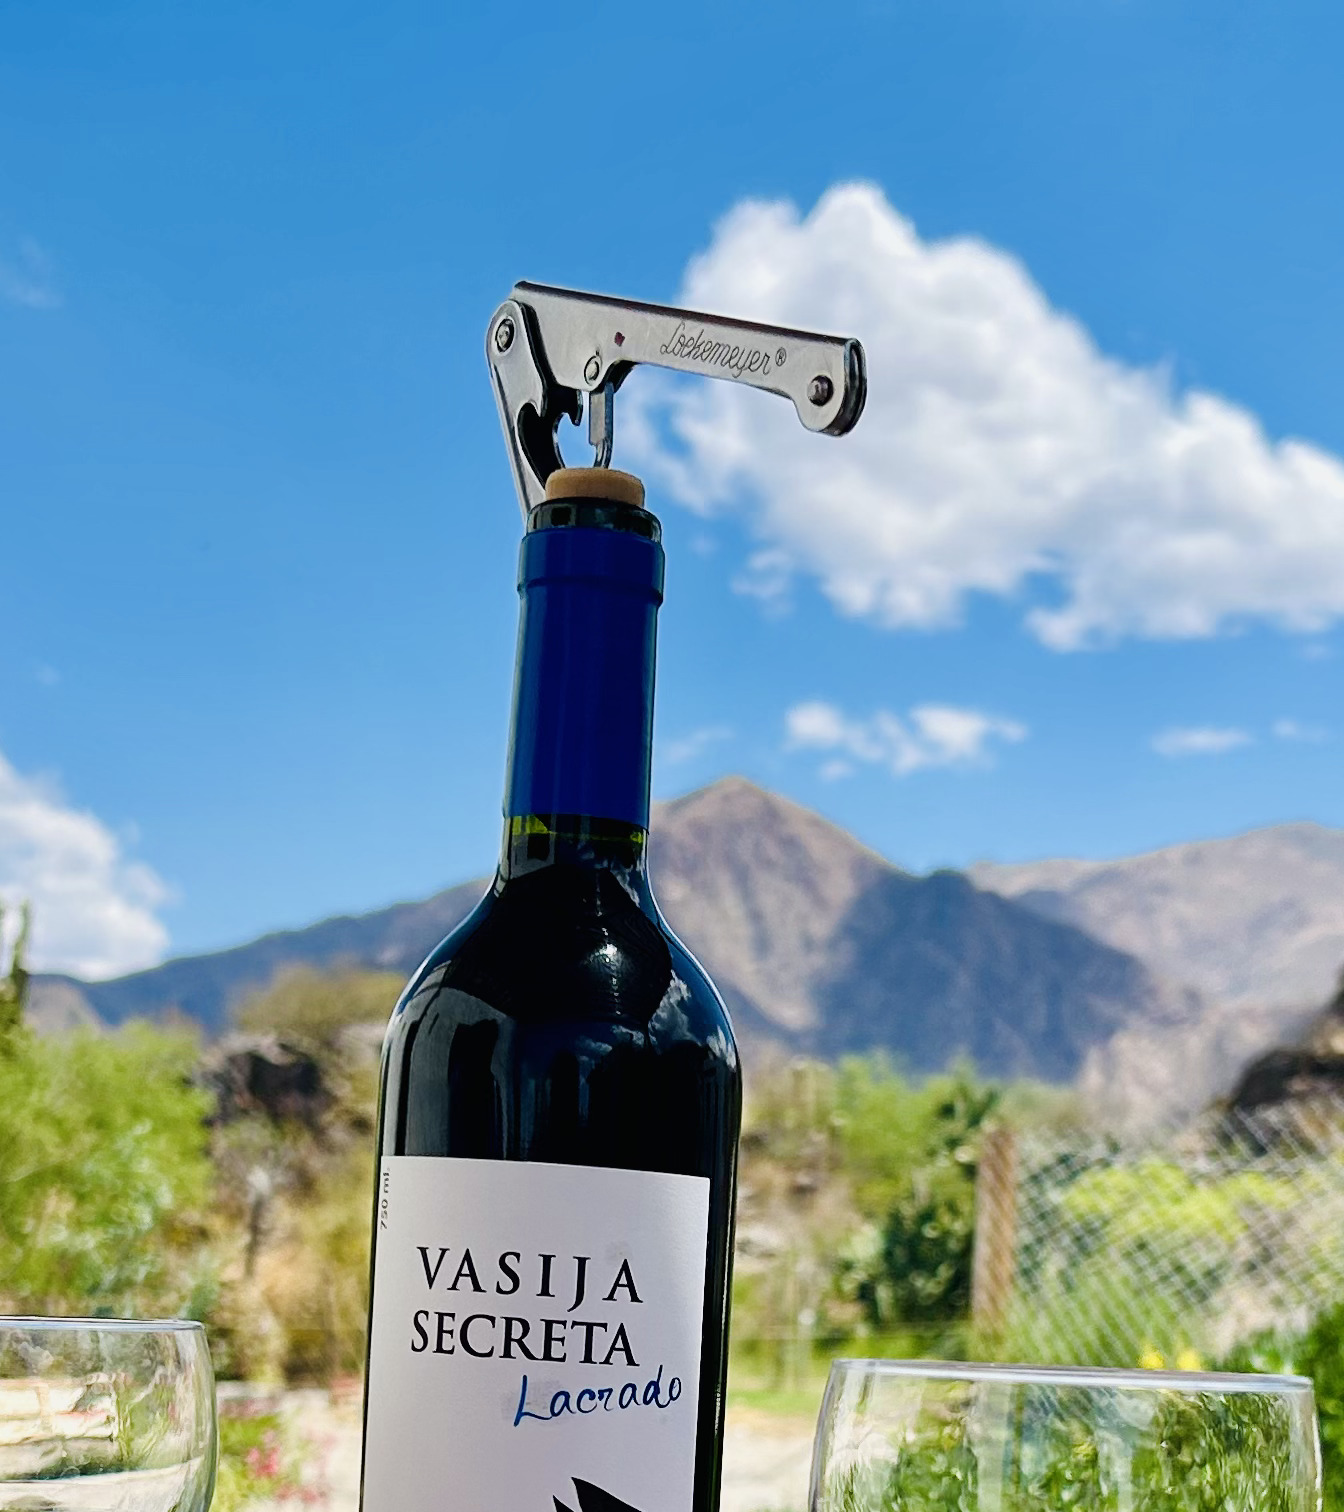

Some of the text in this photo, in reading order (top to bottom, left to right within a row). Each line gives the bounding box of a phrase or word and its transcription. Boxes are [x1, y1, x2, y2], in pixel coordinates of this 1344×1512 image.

[379, 1198, 389, 1231] 750
[416, 1246, 644, 1313] VASIJA
[410, 1309, 640, 1367] SECRETA
[513, 1364, 683, 1427] Lacrado
